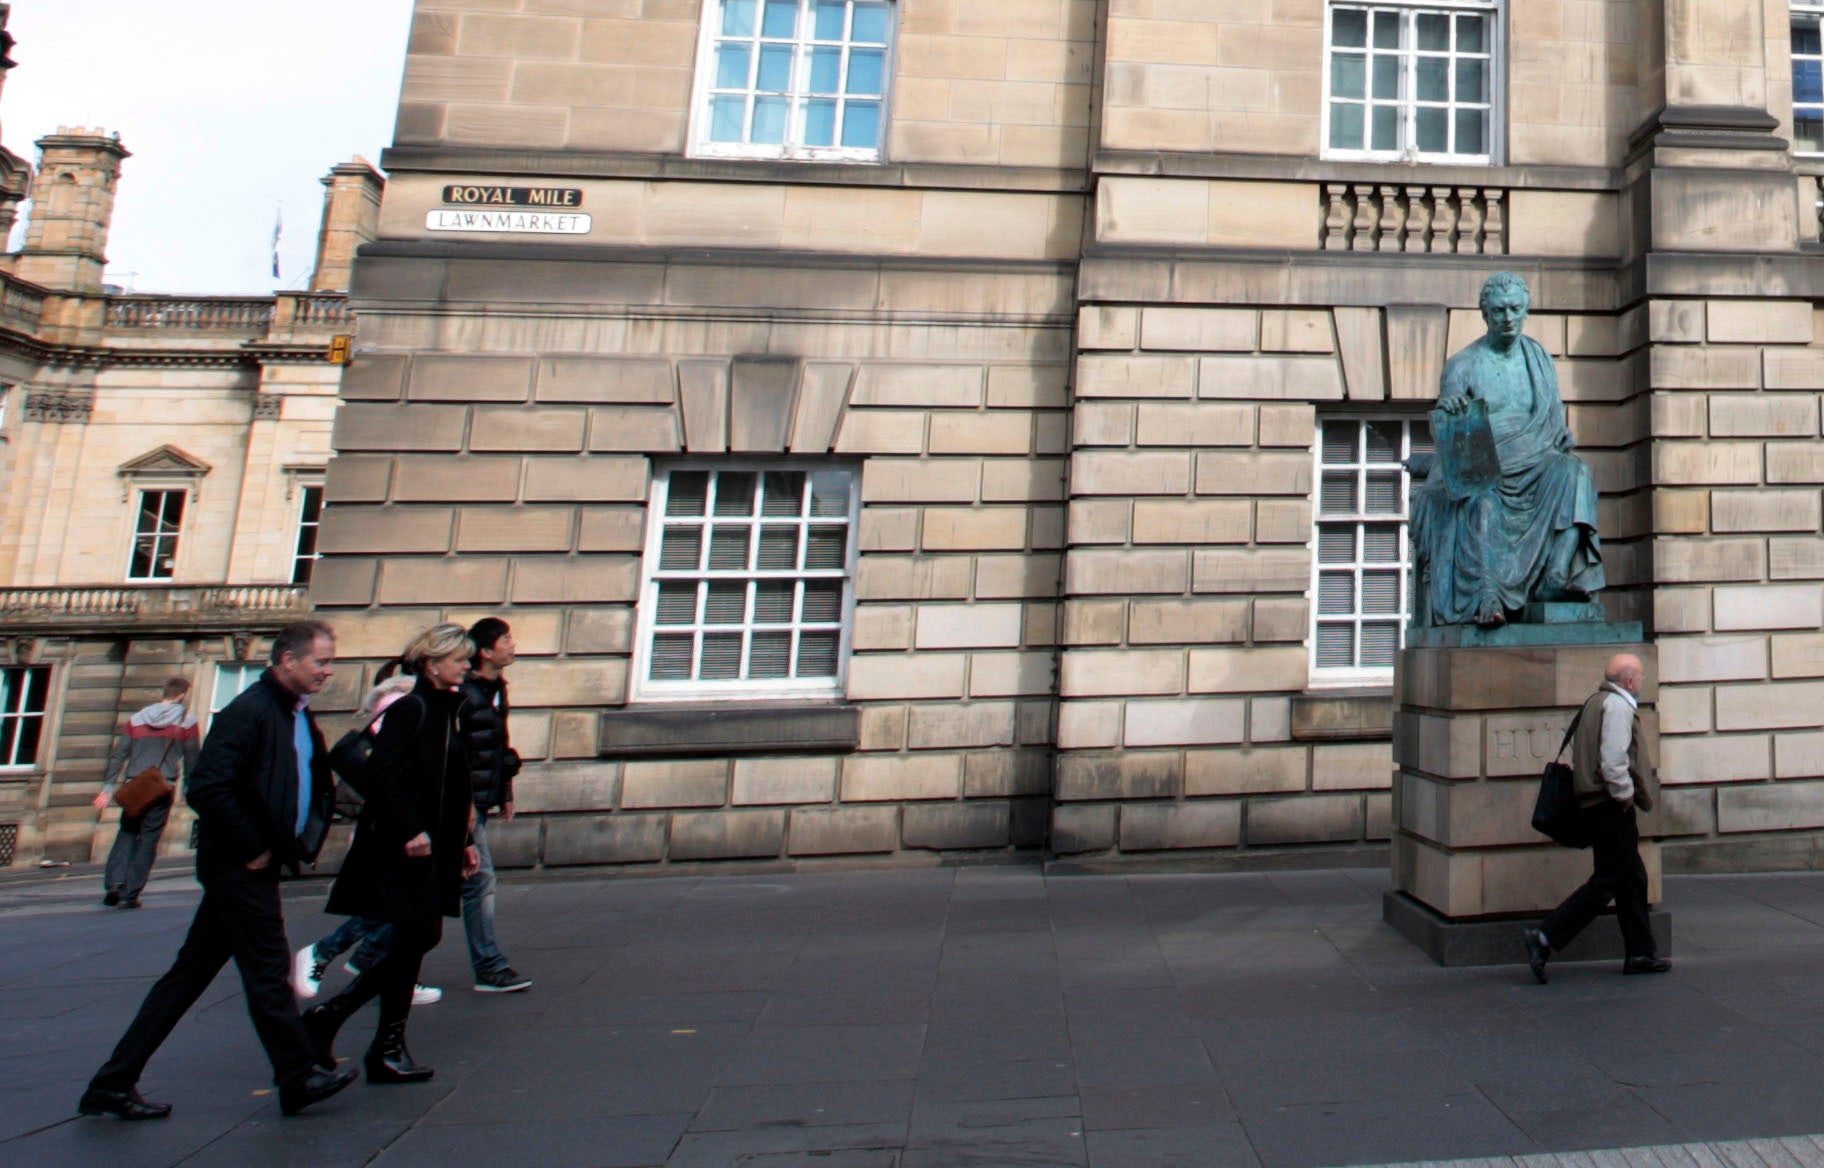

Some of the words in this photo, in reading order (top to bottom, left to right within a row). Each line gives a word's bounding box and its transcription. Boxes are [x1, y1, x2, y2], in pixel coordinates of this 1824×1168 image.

[451, 186, 516, 204] ROYAL
[528, 189, 575, 205] MILE
[438, 212, 581, 231] LAWNMARKET
